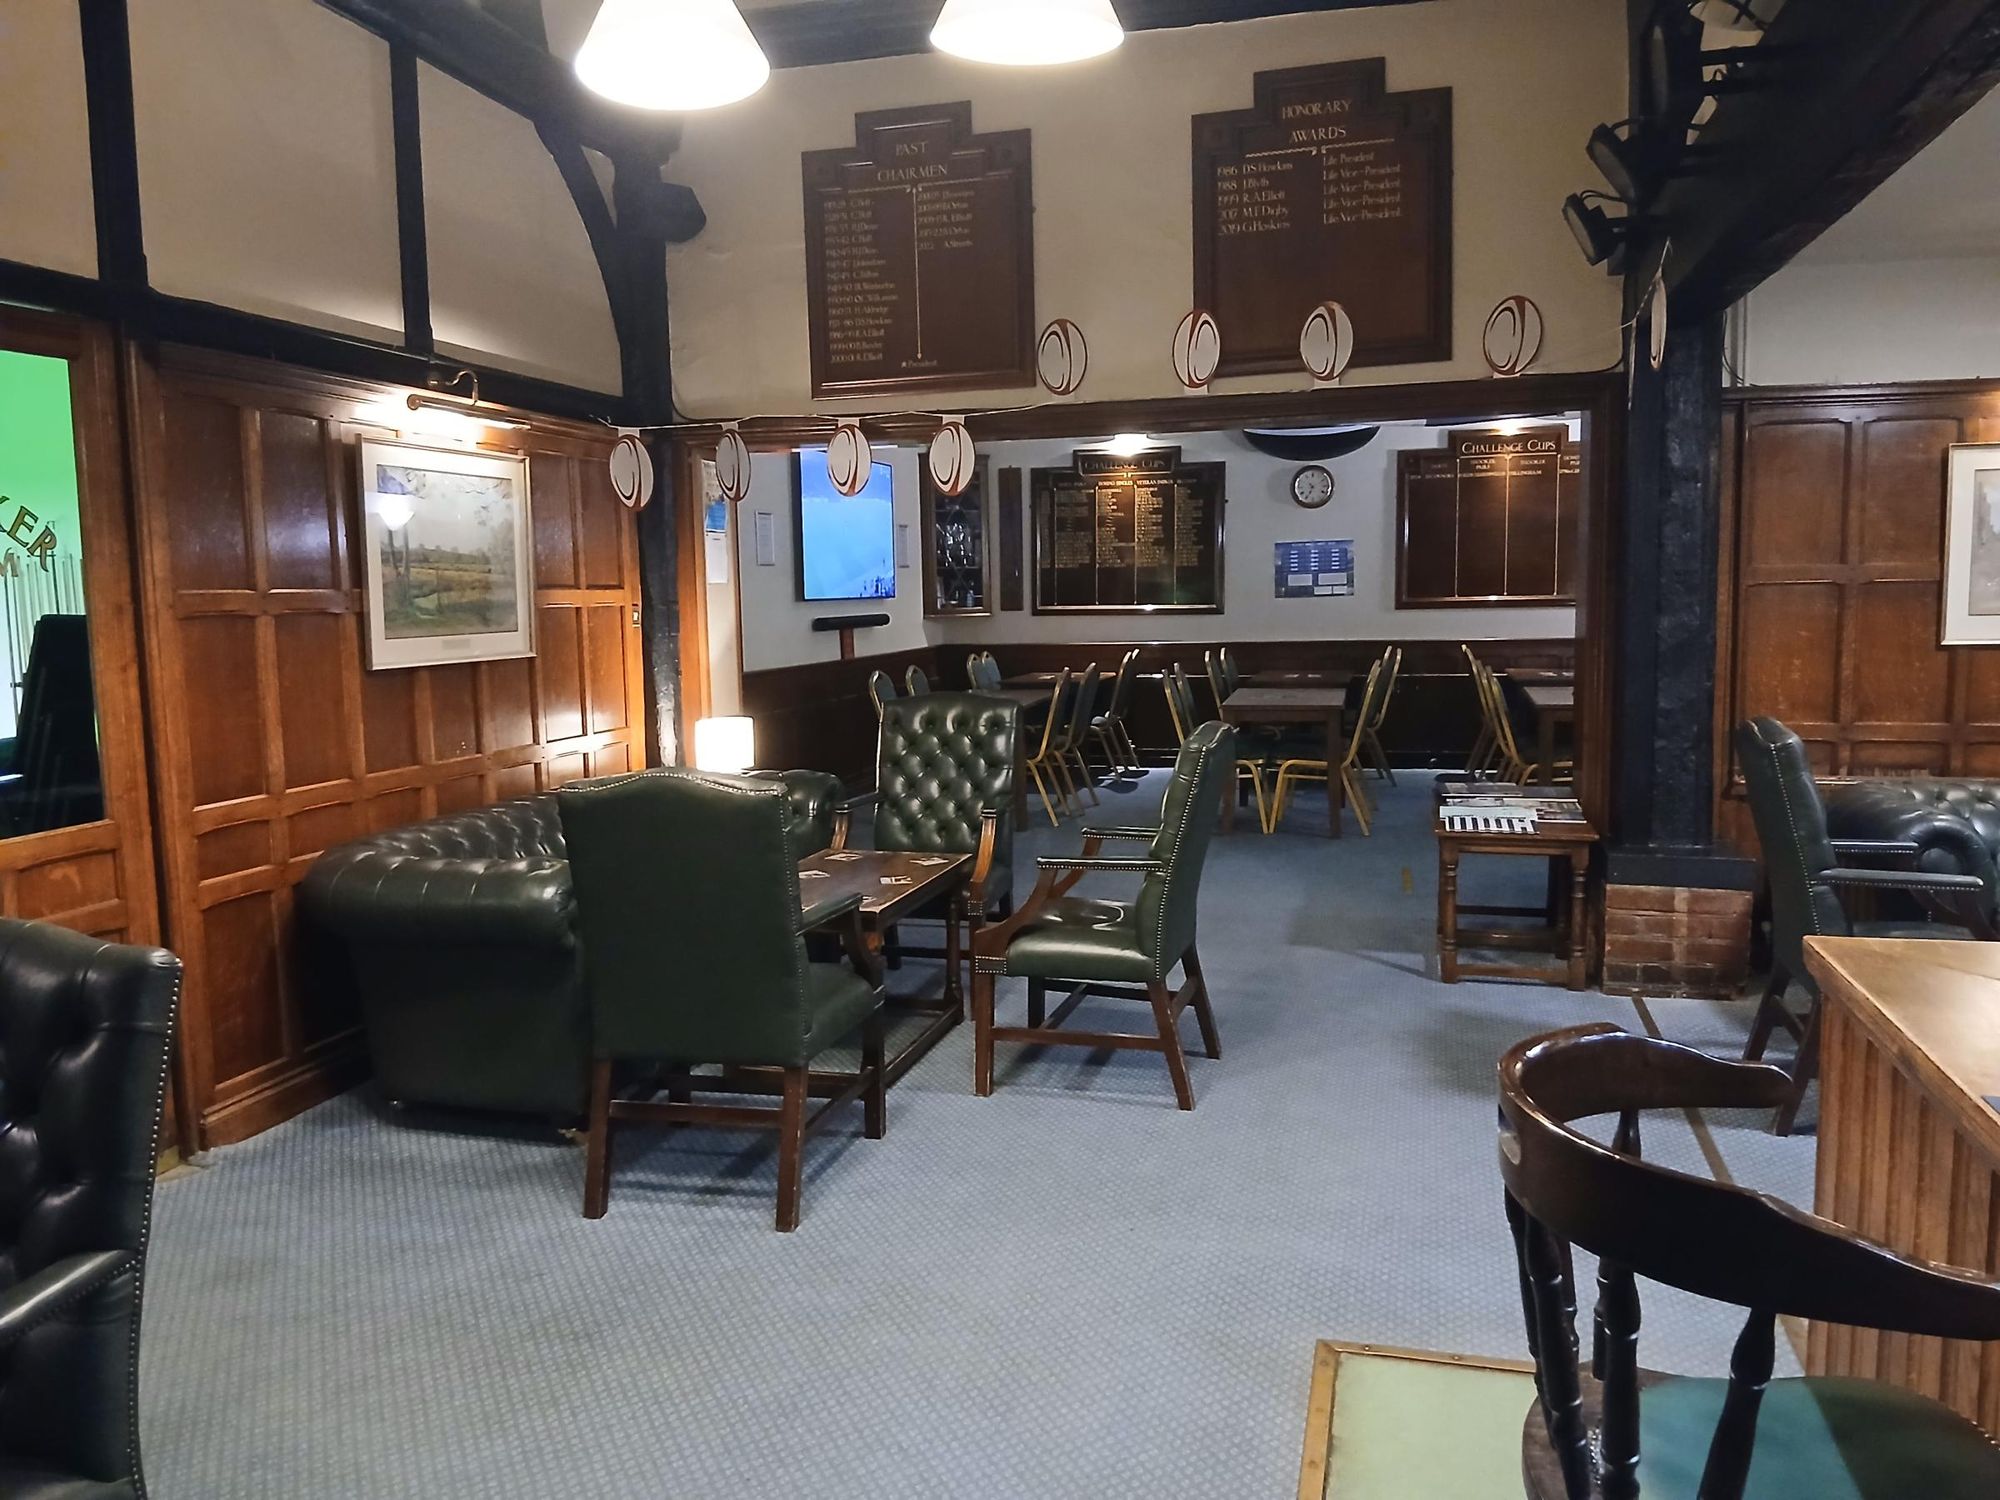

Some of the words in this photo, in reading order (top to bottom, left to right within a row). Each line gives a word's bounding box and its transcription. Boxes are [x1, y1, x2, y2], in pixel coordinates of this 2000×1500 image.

[1282, 99, 1352, 119] HONORARY
[1289, 126, 1347, 143] AWARDS
[895, 140, 928, 156] PAST
[877, 163, 948, 181] CHAIRMEN
[1461, 441, 1523, 455] CHALLENGE
[1526, 438, 1557, 452] CUPS
